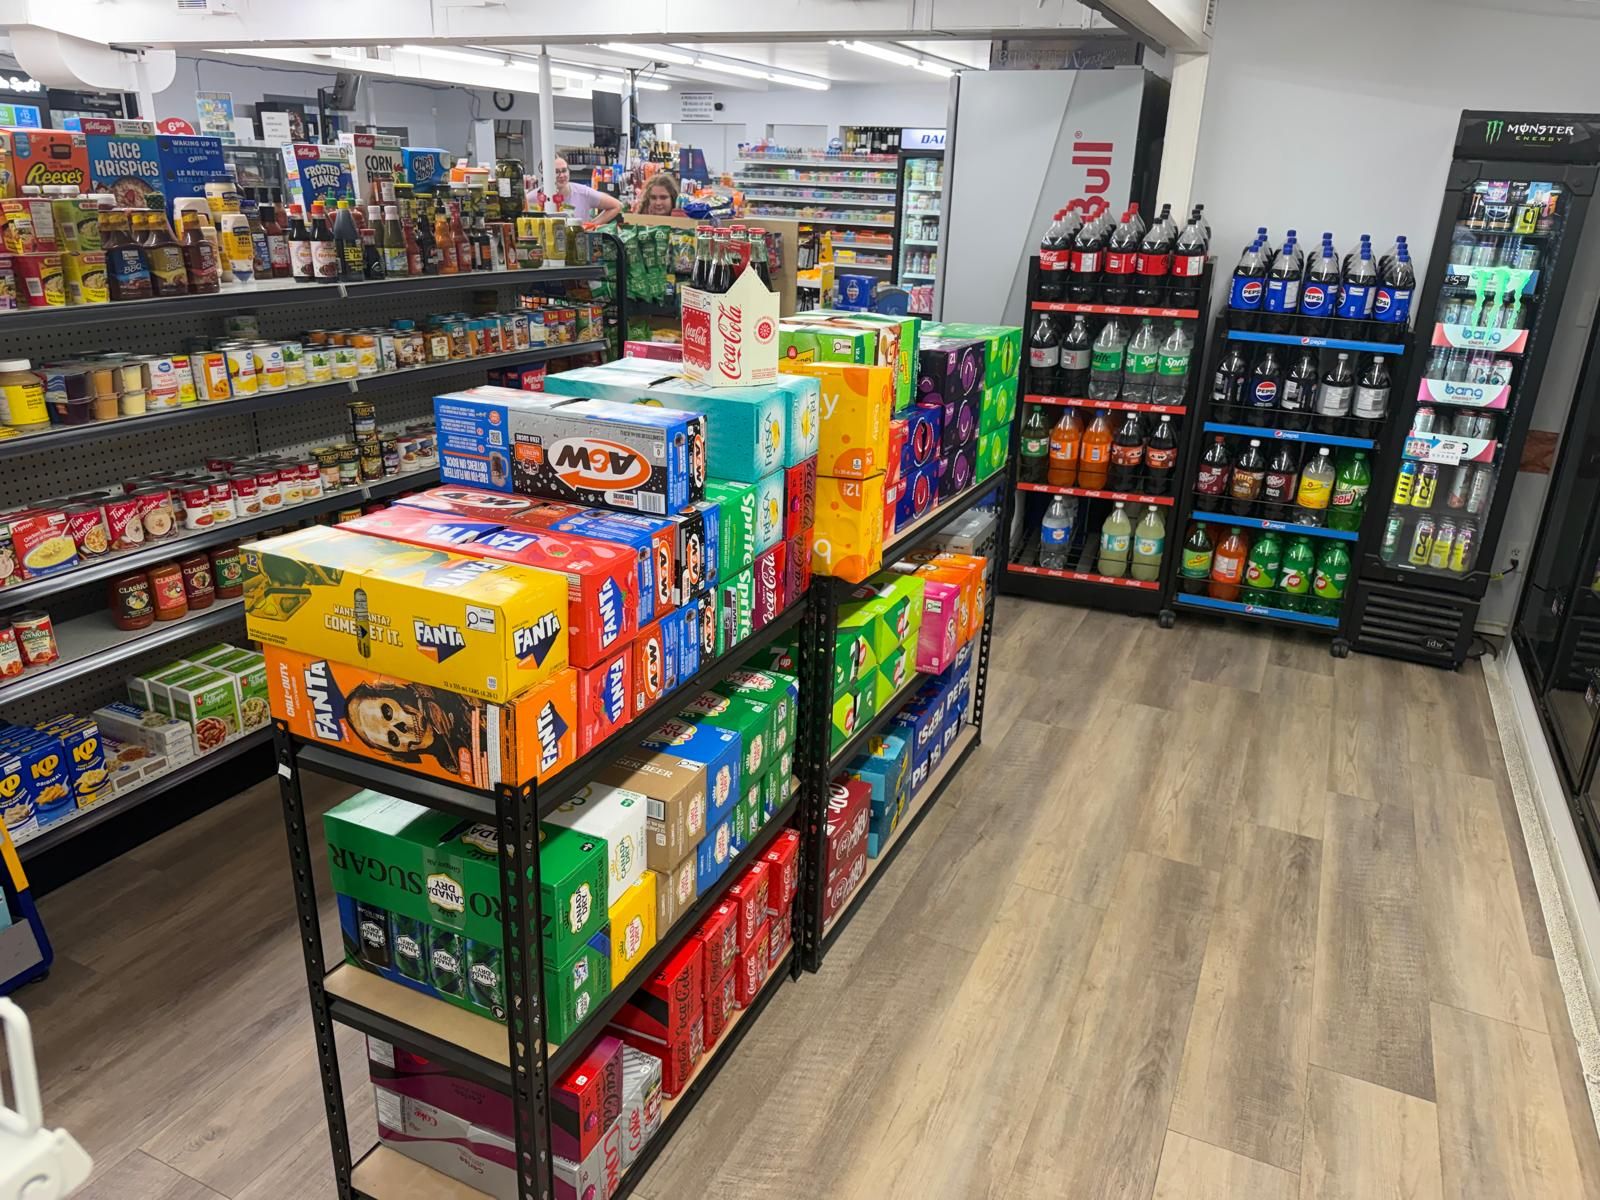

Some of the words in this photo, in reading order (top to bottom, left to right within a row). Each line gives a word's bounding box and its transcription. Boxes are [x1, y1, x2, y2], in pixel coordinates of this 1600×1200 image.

[920, 134, 945, 144] DAI
[1507, 122, 1575, 136] MONSTER
[304, 164, 341, 178] FROSTED
[365, 155, 392, 170] CORN
[310, 176, 340, 189] FLAKES
[1304, 293, 1324, 302] PEPSI
[718, 301, 742, 380] Coca-Cola
[1256, 387, 1276, 396] PEPSI
[1444, 383, 1483, 400] bang
[557, 445, 637, 476] A&W
[70, 517, 84, 529] Tim
[110, 507, 125, 520] Tim
[114, 508, 139, 532] Hortons
[73, 517, 98, 542] Hortons
[741, 493, 755, 575] Sprite
[761, 552, 777, 625] Coca-Cola
[333, 604, 355, 616] WANT
[367, 613, 391, 626] ANTA?
[599, 577, 618, 649] FANTA
[738, 569, 752, 640] Sprite
[324, 614, 357, 635] COME
[369, 625, 384, 642] ET
[387, 629, 404, 648] IT.
[413, 620, 465, 647] FANTA
[513, 612, 561, 656] FANTA
[304, 661, 341, 742] FANTA
[610, 657, 625, 723] FANTA
[536, 702, 559, 773] FANTA
[73, 738, 98, 762] KD
[31, 755, 59, 779] KD
[643, 765, 673, 779] BEER
[36, 774, 62, 787] ORIGINAL
[327, 842, 423, 895] SUGAR
[620, 839, 628, 879] CANADA
[426, 886, 464, 905] CANADA
[434, 880, 456, 894] DRY
[576, 888, 584, 932] CANADA
[582, 894, 591, 914] DRY
[414, 1110, 438, 1128] Coke
